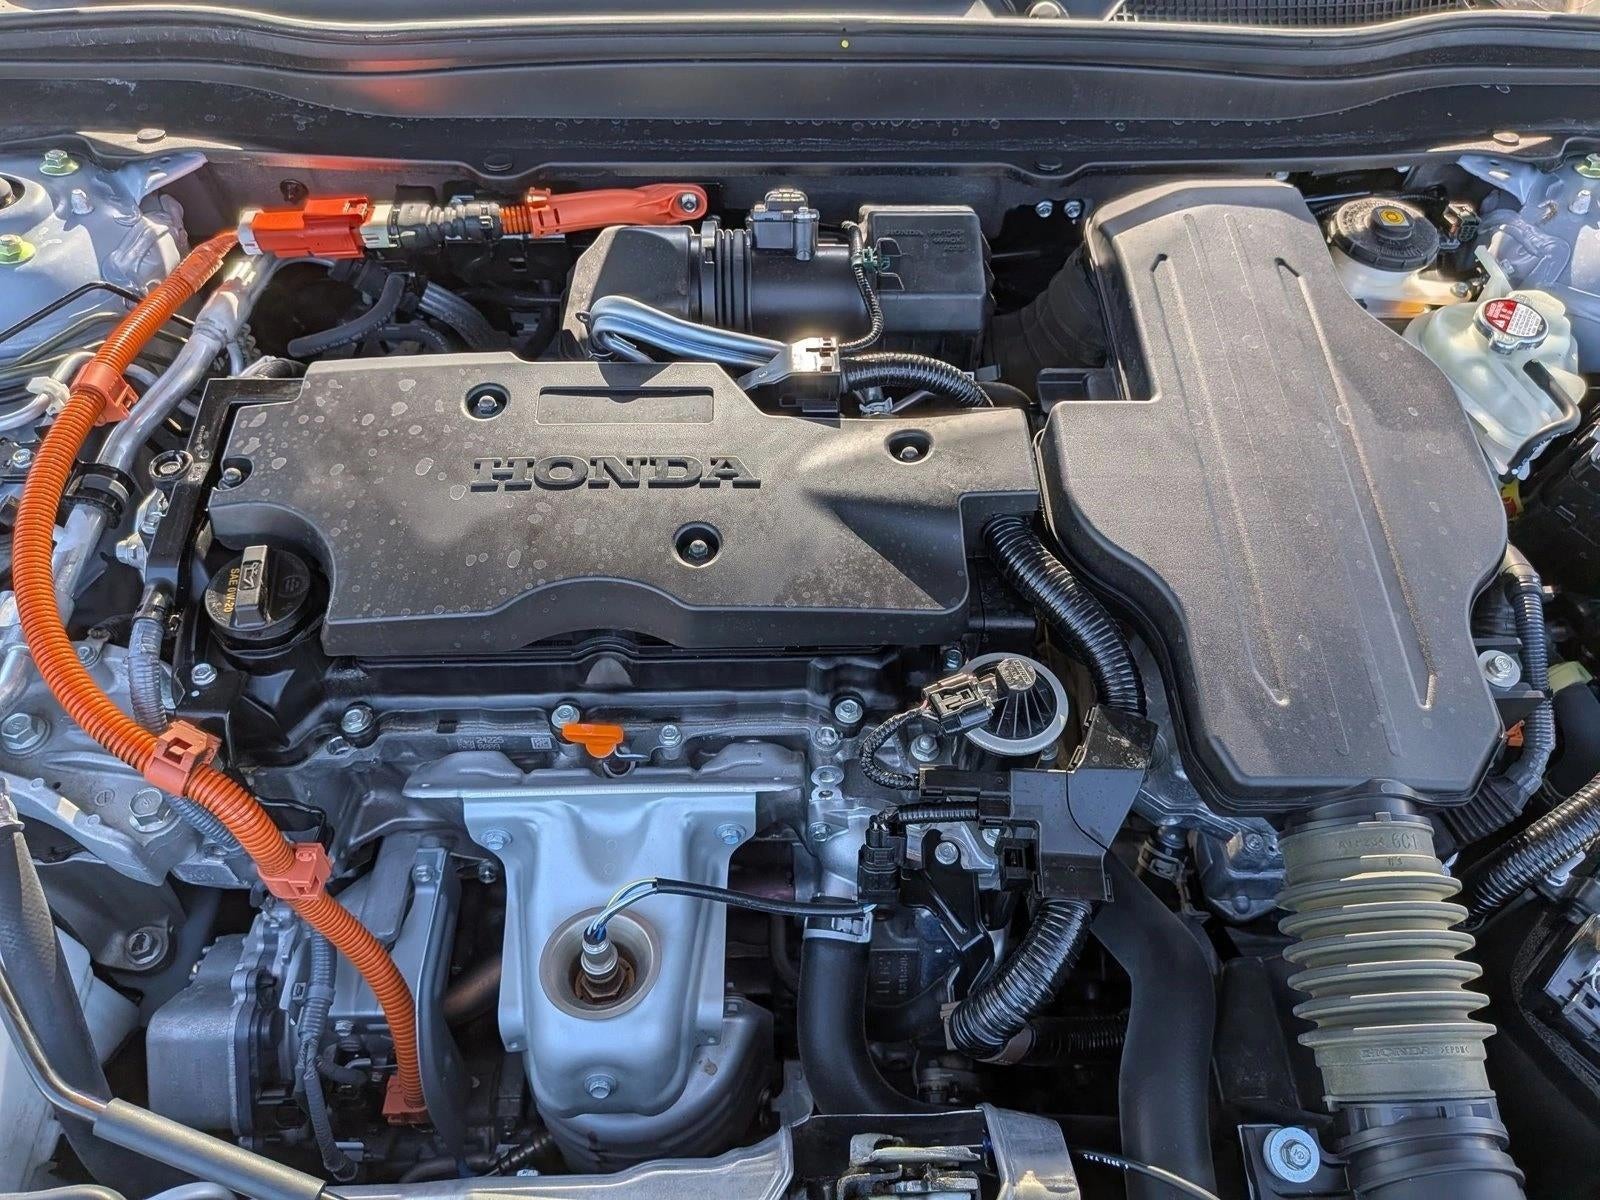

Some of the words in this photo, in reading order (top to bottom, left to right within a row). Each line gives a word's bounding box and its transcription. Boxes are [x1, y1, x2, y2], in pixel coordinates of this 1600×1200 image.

[470, 455, 761, 492] HONDA
[228, 568, 240, 586] SAE
[223, 587, 236, 613] 0W-20
